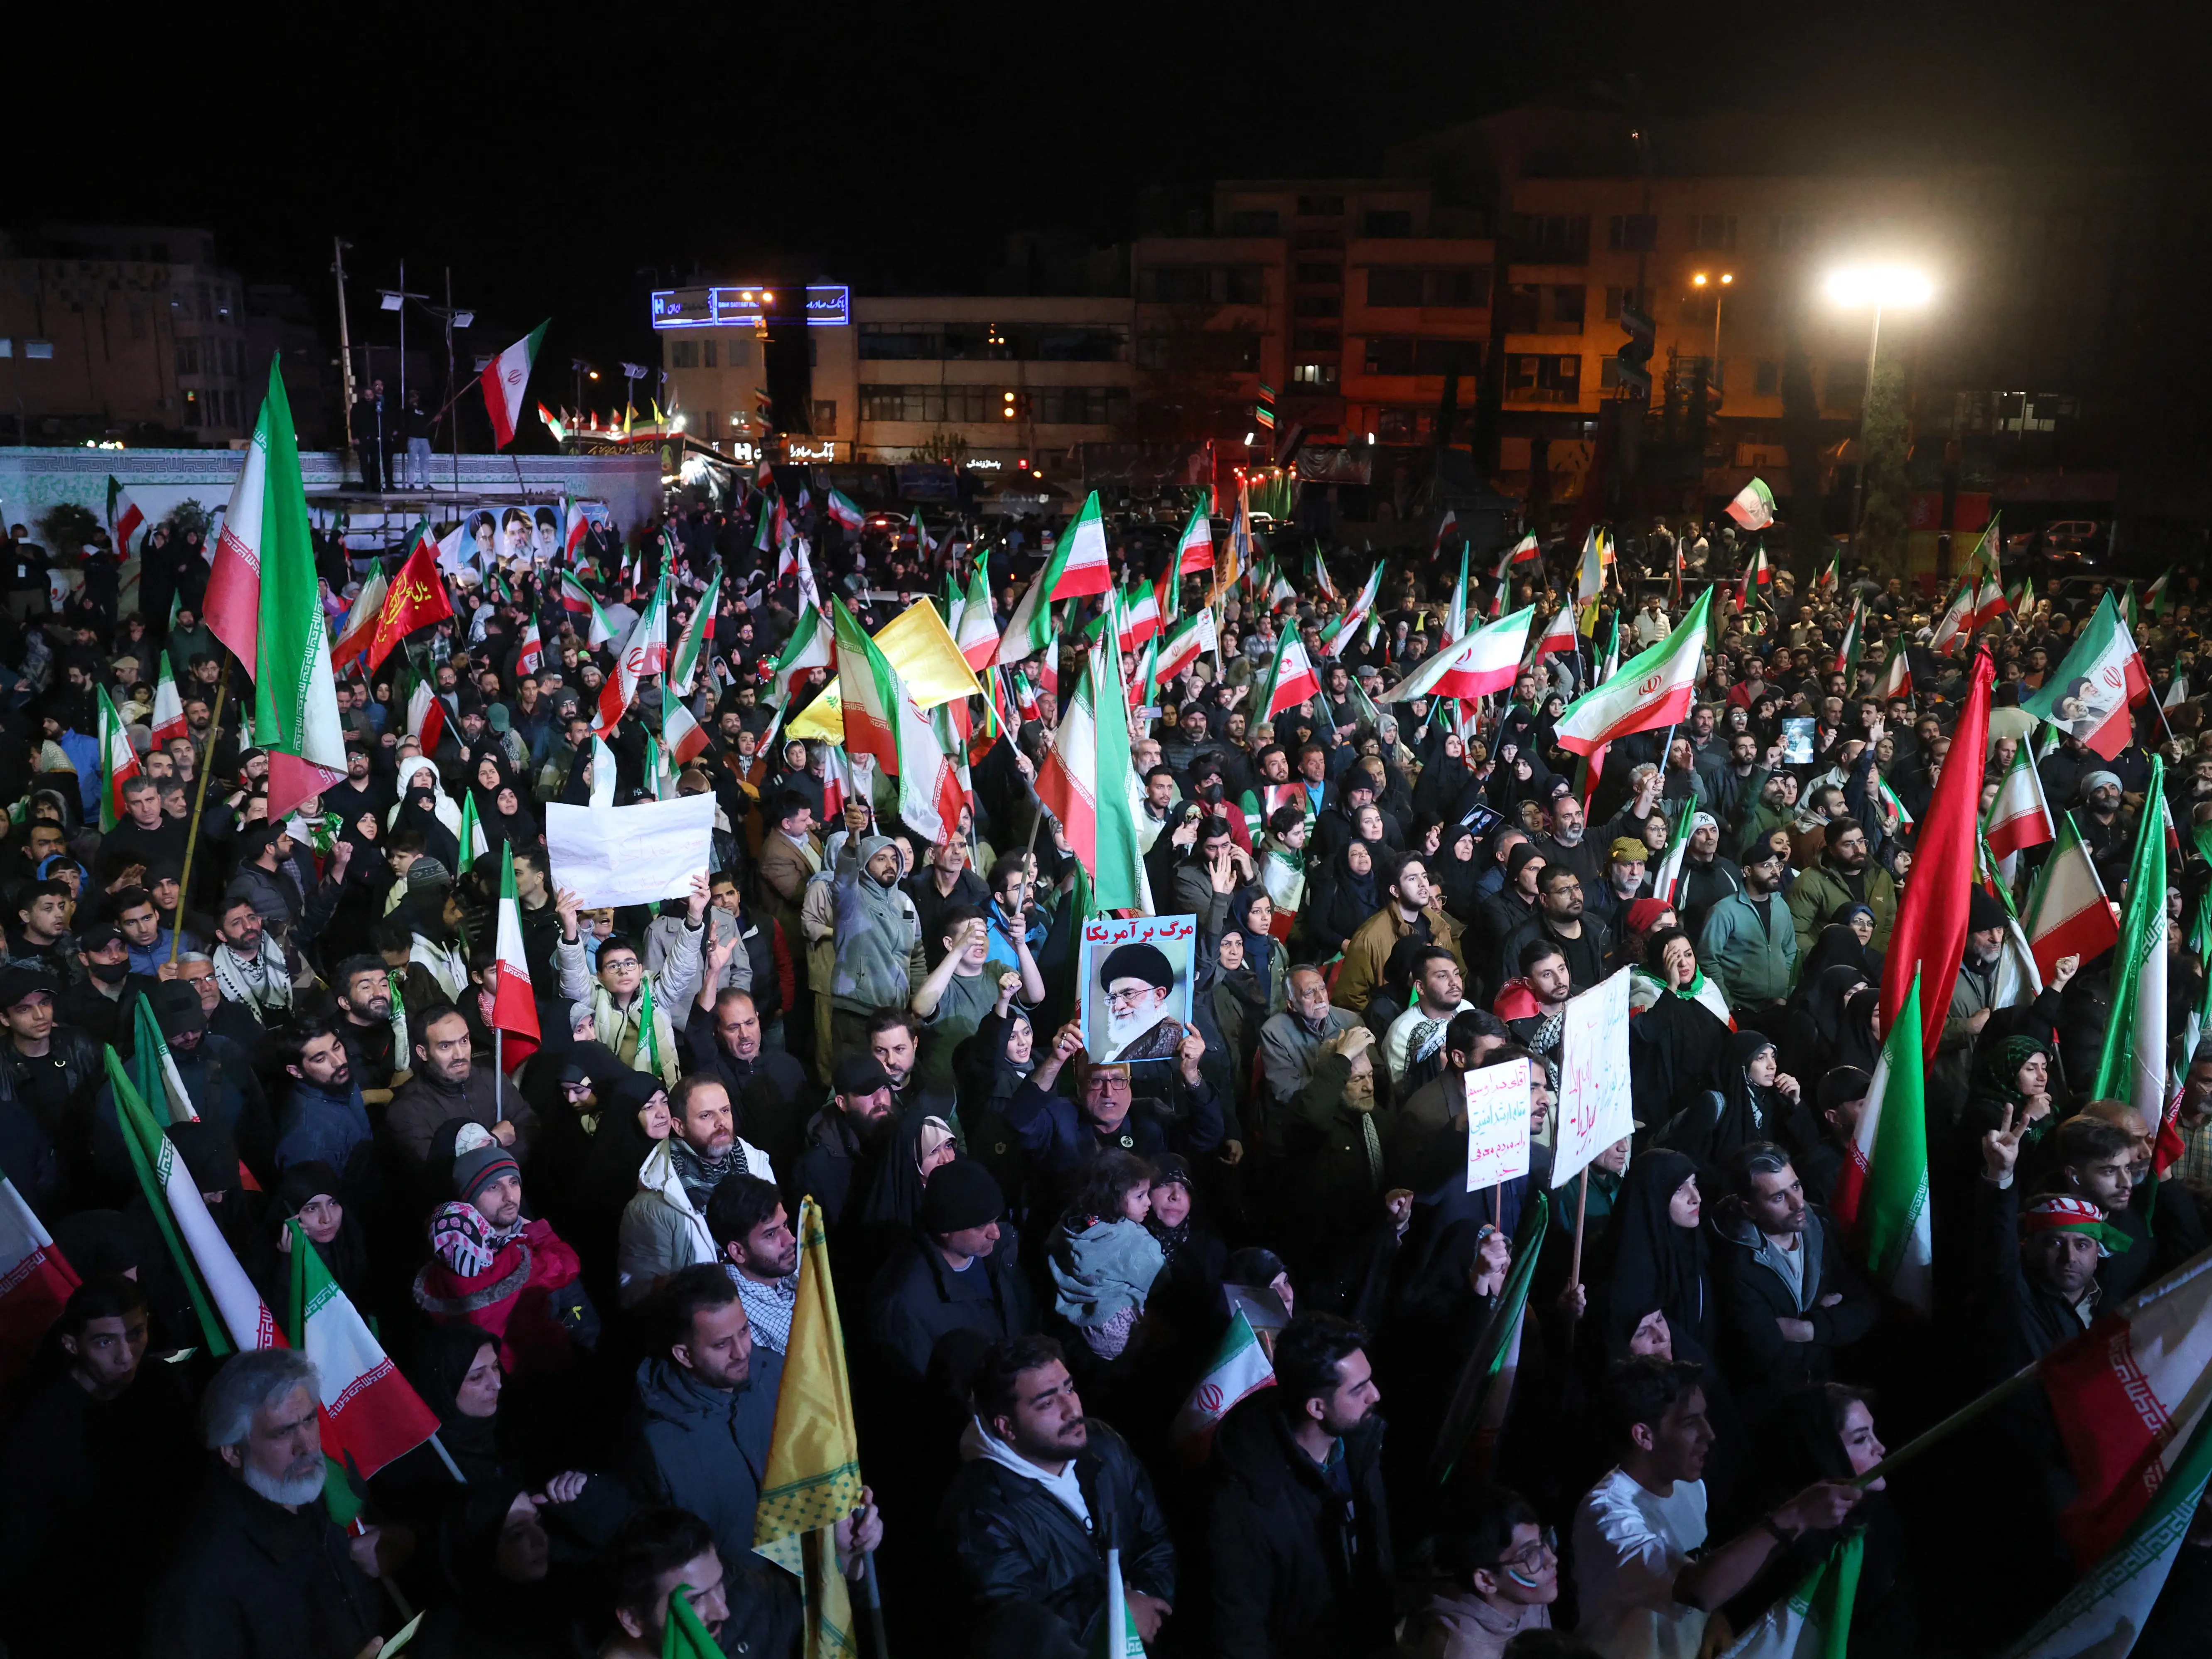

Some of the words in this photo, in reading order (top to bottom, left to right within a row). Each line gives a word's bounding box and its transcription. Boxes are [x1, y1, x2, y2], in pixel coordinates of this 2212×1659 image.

[790, 444, 811, 457] صادرا
[811, 442, 835, 462] بانک
[1699, 814, 1709, 822] NY
[1086, 920, 1139, 945] آمریکا
[1138, 926, 1154, 942] بر
[1159, 920, 1193, 940] مرگ
[1507, 1065, 1527, 1089] آقای
[1471, 1104, 1493, 1136] امنیتی
[1493, 1102, 1512, 1126] ارشد
[1512, 1101, 1526, 1121] مقام
[1470, 1142, 1494, 1162] معرفی
[1495, 1141, 1514, 1159] مردم
